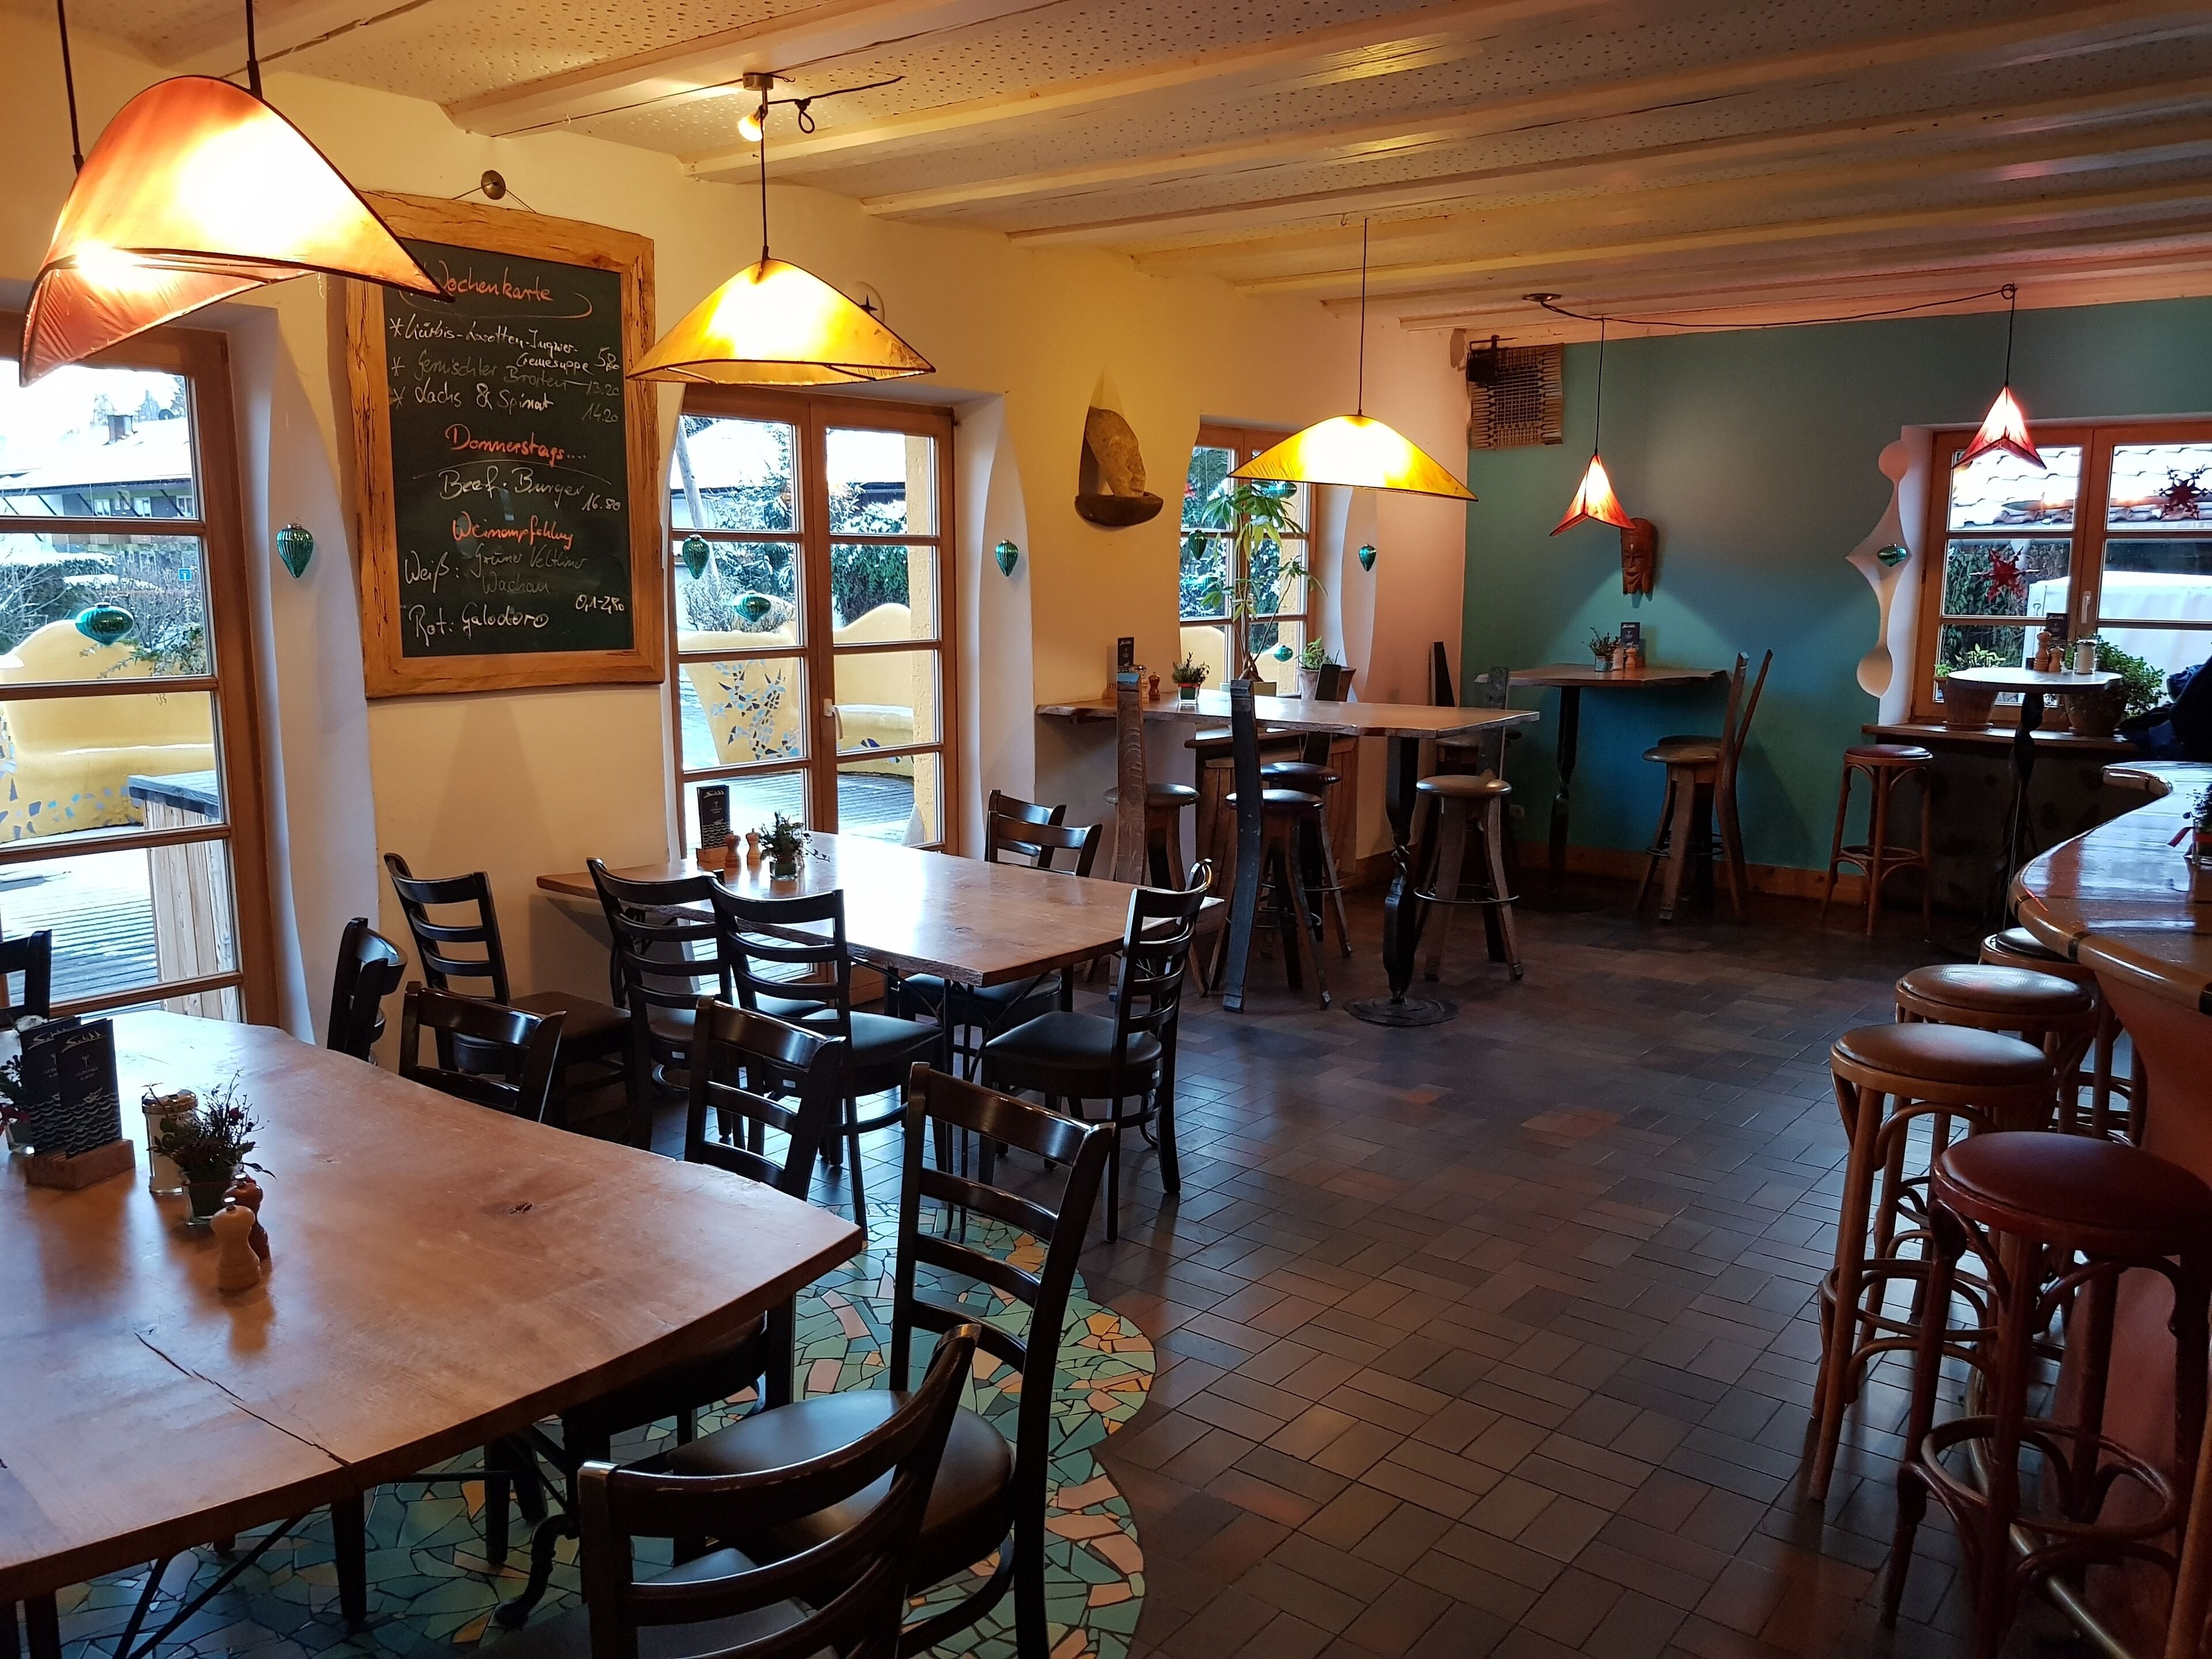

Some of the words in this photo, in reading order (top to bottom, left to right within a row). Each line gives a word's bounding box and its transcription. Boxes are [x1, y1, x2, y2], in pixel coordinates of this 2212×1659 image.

[414, 349, 498, 381] Gemischter
[503, 365, 567, 391] Braten
[516, 352, 594, 376] Cremesuppe
[415, 376, 461, 408] Lachs
[476, 382, 494, 410] &
[497, 389, 555, 415] Spinat
[581, 492, 621, 512] 16.80
[452, 510, 574, 551] Weinempfehlung
[470, 543, 524, 578] Grüner
[482, 570, 551, 595] Wachau
